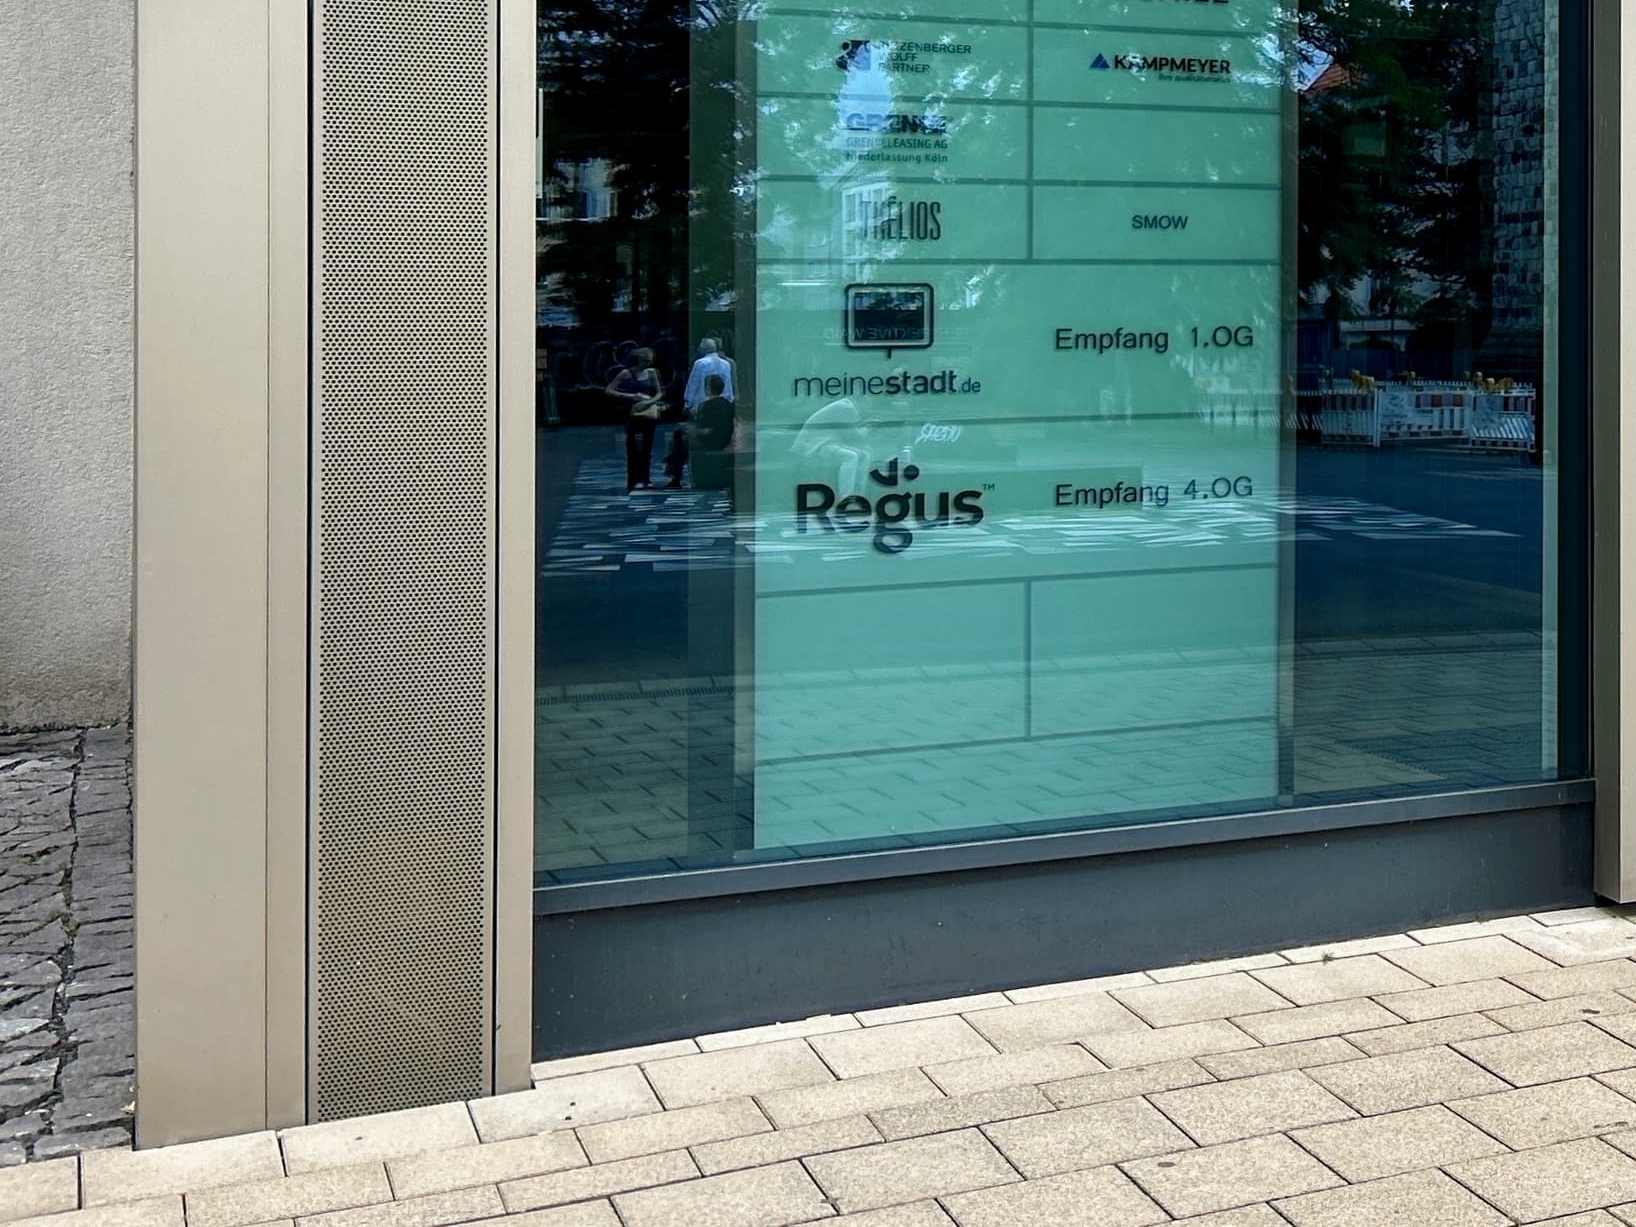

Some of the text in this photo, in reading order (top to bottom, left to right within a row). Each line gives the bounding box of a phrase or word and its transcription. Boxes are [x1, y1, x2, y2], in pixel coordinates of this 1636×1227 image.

[933, 138, 949, 150] AG
[1131, 213, 1189, 230] SMOW
[1054, 325, 1254, 354] Empfang 1.OG
[793, 369, 982, 397] meinestadt.de
[1055, 476, 1254, 507] Empfang 4.OG
